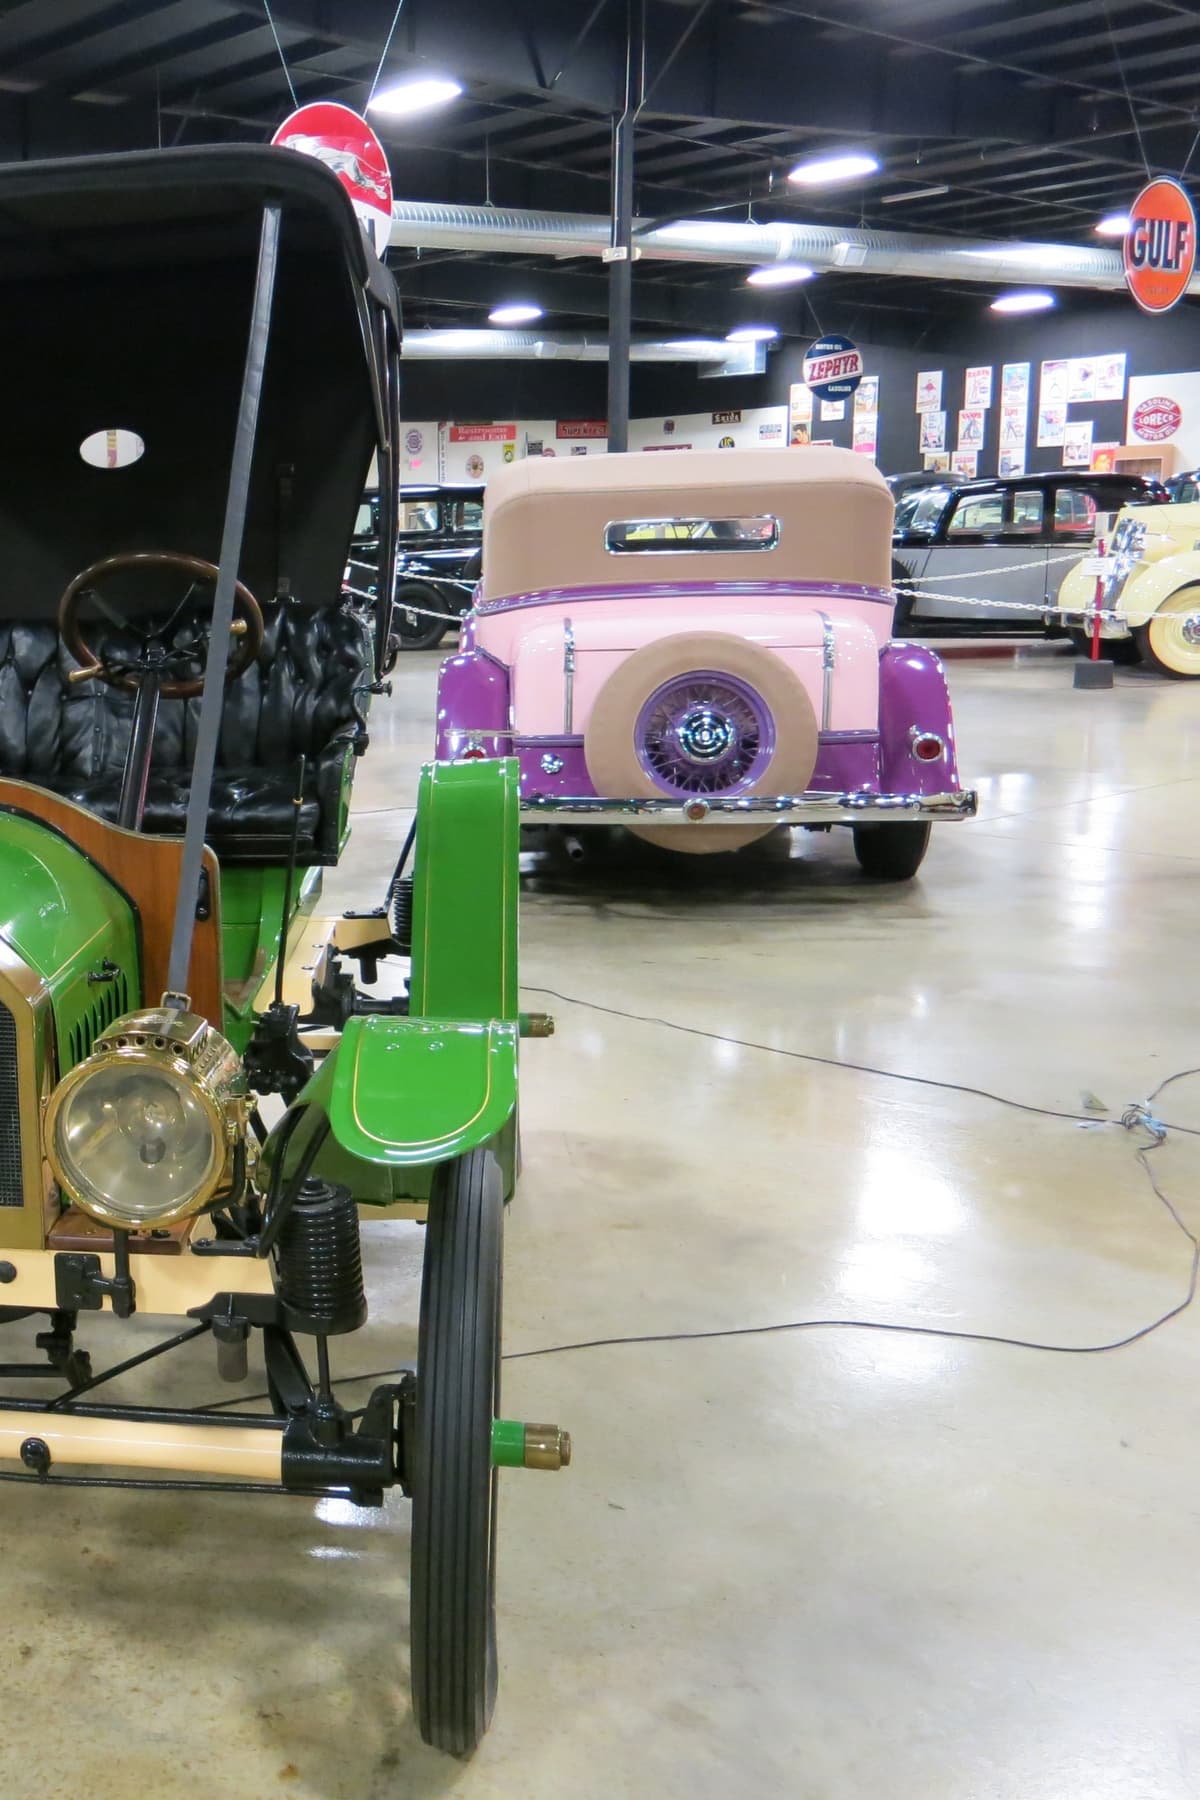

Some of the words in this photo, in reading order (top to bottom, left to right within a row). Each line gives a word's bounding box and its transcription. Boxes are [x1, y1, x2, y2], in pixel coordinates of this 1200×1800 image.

[1130, 217, 1189, 270] GULF
[808, 353, 859, 382] ZEPHYR
[1139, 412, 1174, 426] LORECO
